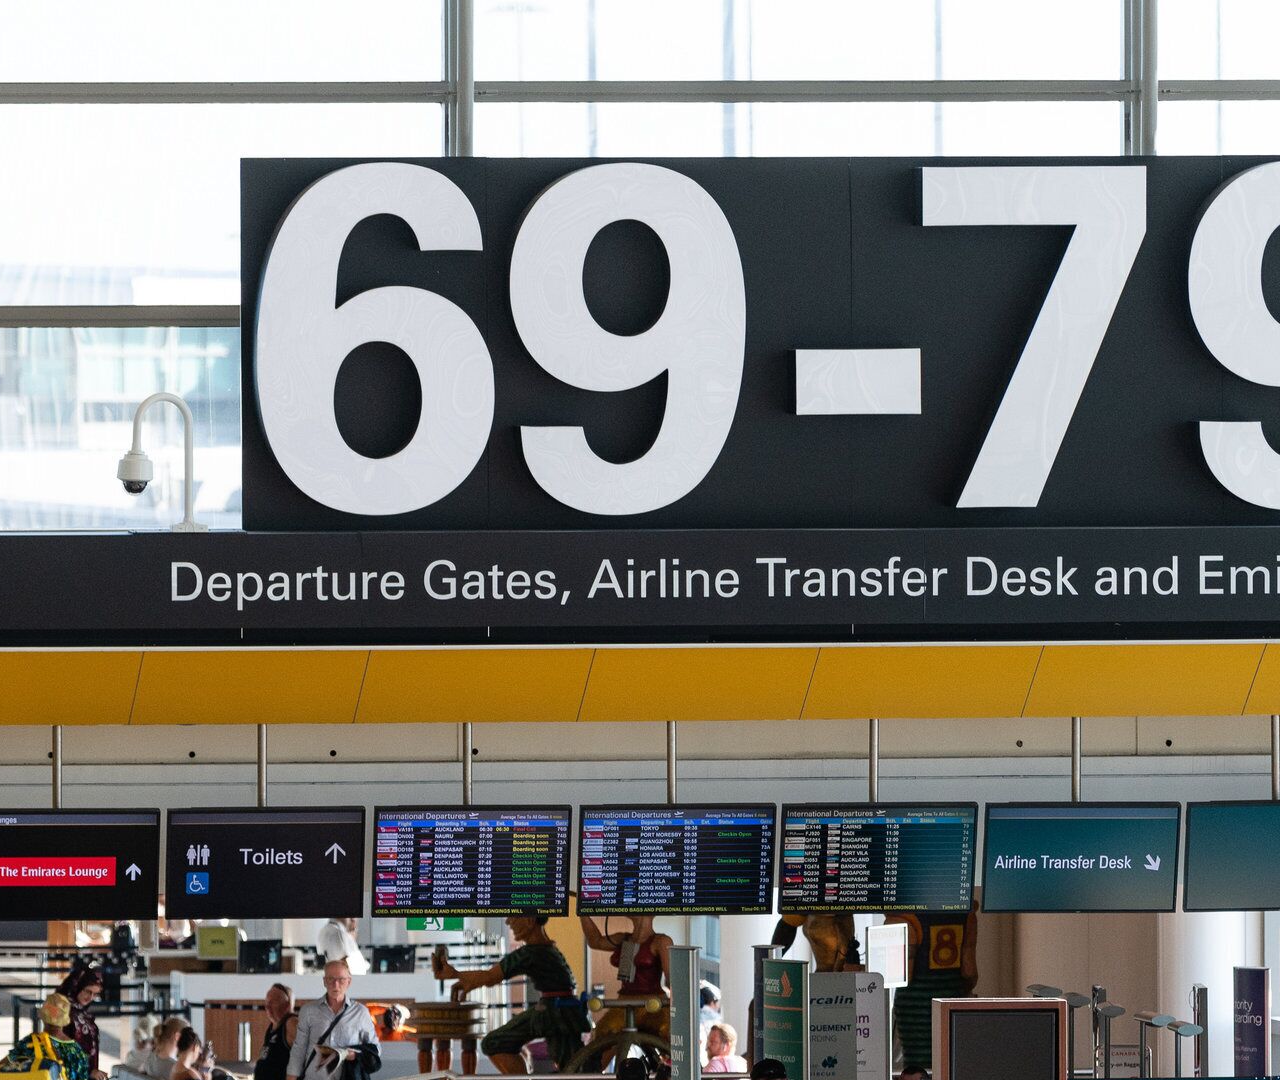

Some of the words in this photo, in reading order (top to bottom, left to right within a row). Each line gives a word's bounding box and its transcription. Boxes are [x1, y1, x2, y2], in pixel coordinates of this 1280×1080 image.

[169, 559, 408, 606] Departure
[422, 558, 573, 606] Gates,
[588, 556, 743, 599] Airline
[757, 556, 950, 599] Transfer
[966, 556, 1080, 598] Desk
[1094, 556, 1183, 597] and
[379, 812, 424, 820] International
[426, 812, 466, 820] Departures
[787, 810, 831, 818] International
[834, 810, 873, 818] Departures
[239, 848, 303, 865] Toilets
[994, 853, 1036, 869] Airline
[1040, 853, 1095, 869] Transfer
[1099, 853, 1132, 869] Desk
[0, 866, 19, 877] The
[21, 866, 66, 877] Emirates
[69, 866, 108, 879] Lounge
[933, 928, 958, 967] 8
[810, 995, 853, 1005] rcalin
[810, 1024, 851, 1032] QUEMENT
